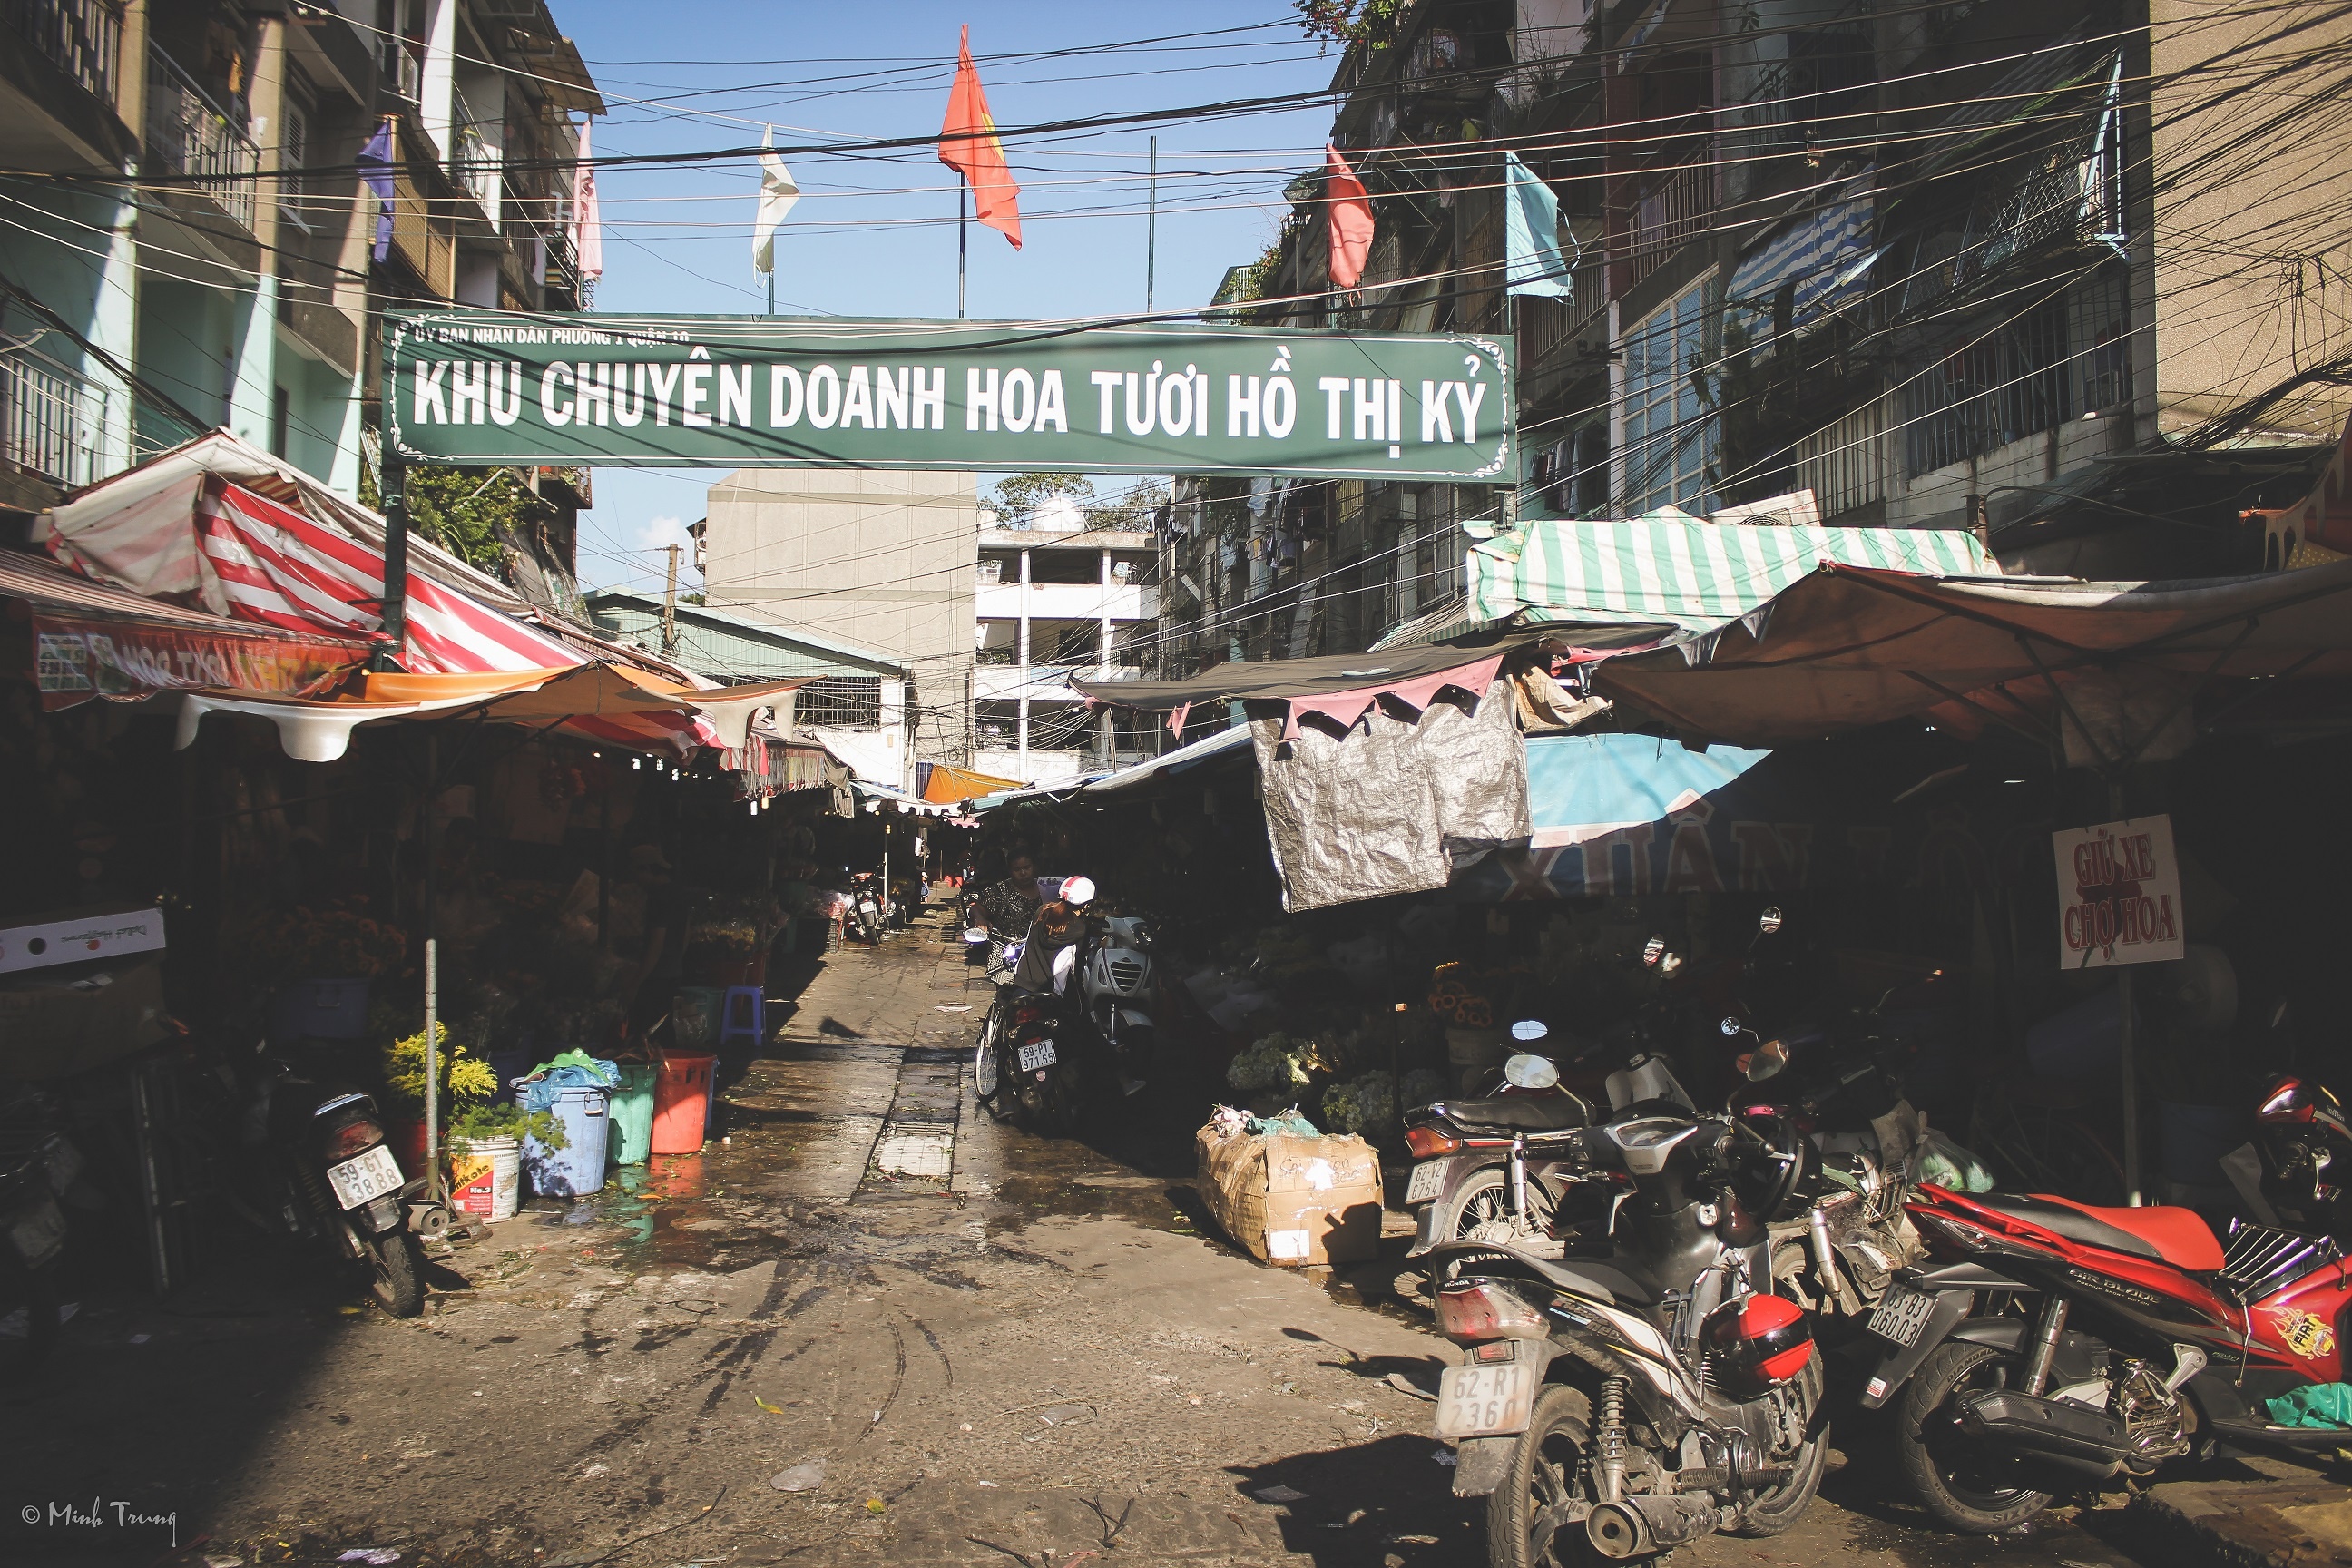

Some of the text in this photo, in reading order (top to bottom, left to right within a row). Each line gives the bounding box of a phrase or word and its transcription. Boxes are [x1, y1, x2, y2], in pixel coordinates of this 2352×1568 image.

[438, 328, 469, 343] BAN
[516, 326, 548, 344] DÂN
[414, 344, 1488, 459] KHU CHUYÊN DOANH HOA TƯƠI HỒ THỊ KỶ
[2073, 828, 2156, 887] GIỮ XE
[2064, 894, 2178, 961] CHỢ HOA
[1023, 1052, 1054, 1070] 971.65
[1024, 1043, 1048, 1058] 59-P1
[337, 1152, 383, 1185] 59-G1
[1416, 1162, 1444, 1182] 62-V2
[469, 1186, 492, 1194] No.3
[1411, 1181, 1437, 1200] 6764
[1445, 1279, 1471, 1288] HONDA
[2076, 1279, 2151, 1307] PREMIUM SPORT EDITION
[2102, 1279, 2163, 1304] BLADE
[1870, 1307, 1920, 1345] 060.03
[2293, 1316, 2316, 1348] FIAT
[1946, 1348, 1994, 1383] DIAMOND
[1453, 1366, 1520, 1400] 62-R1
